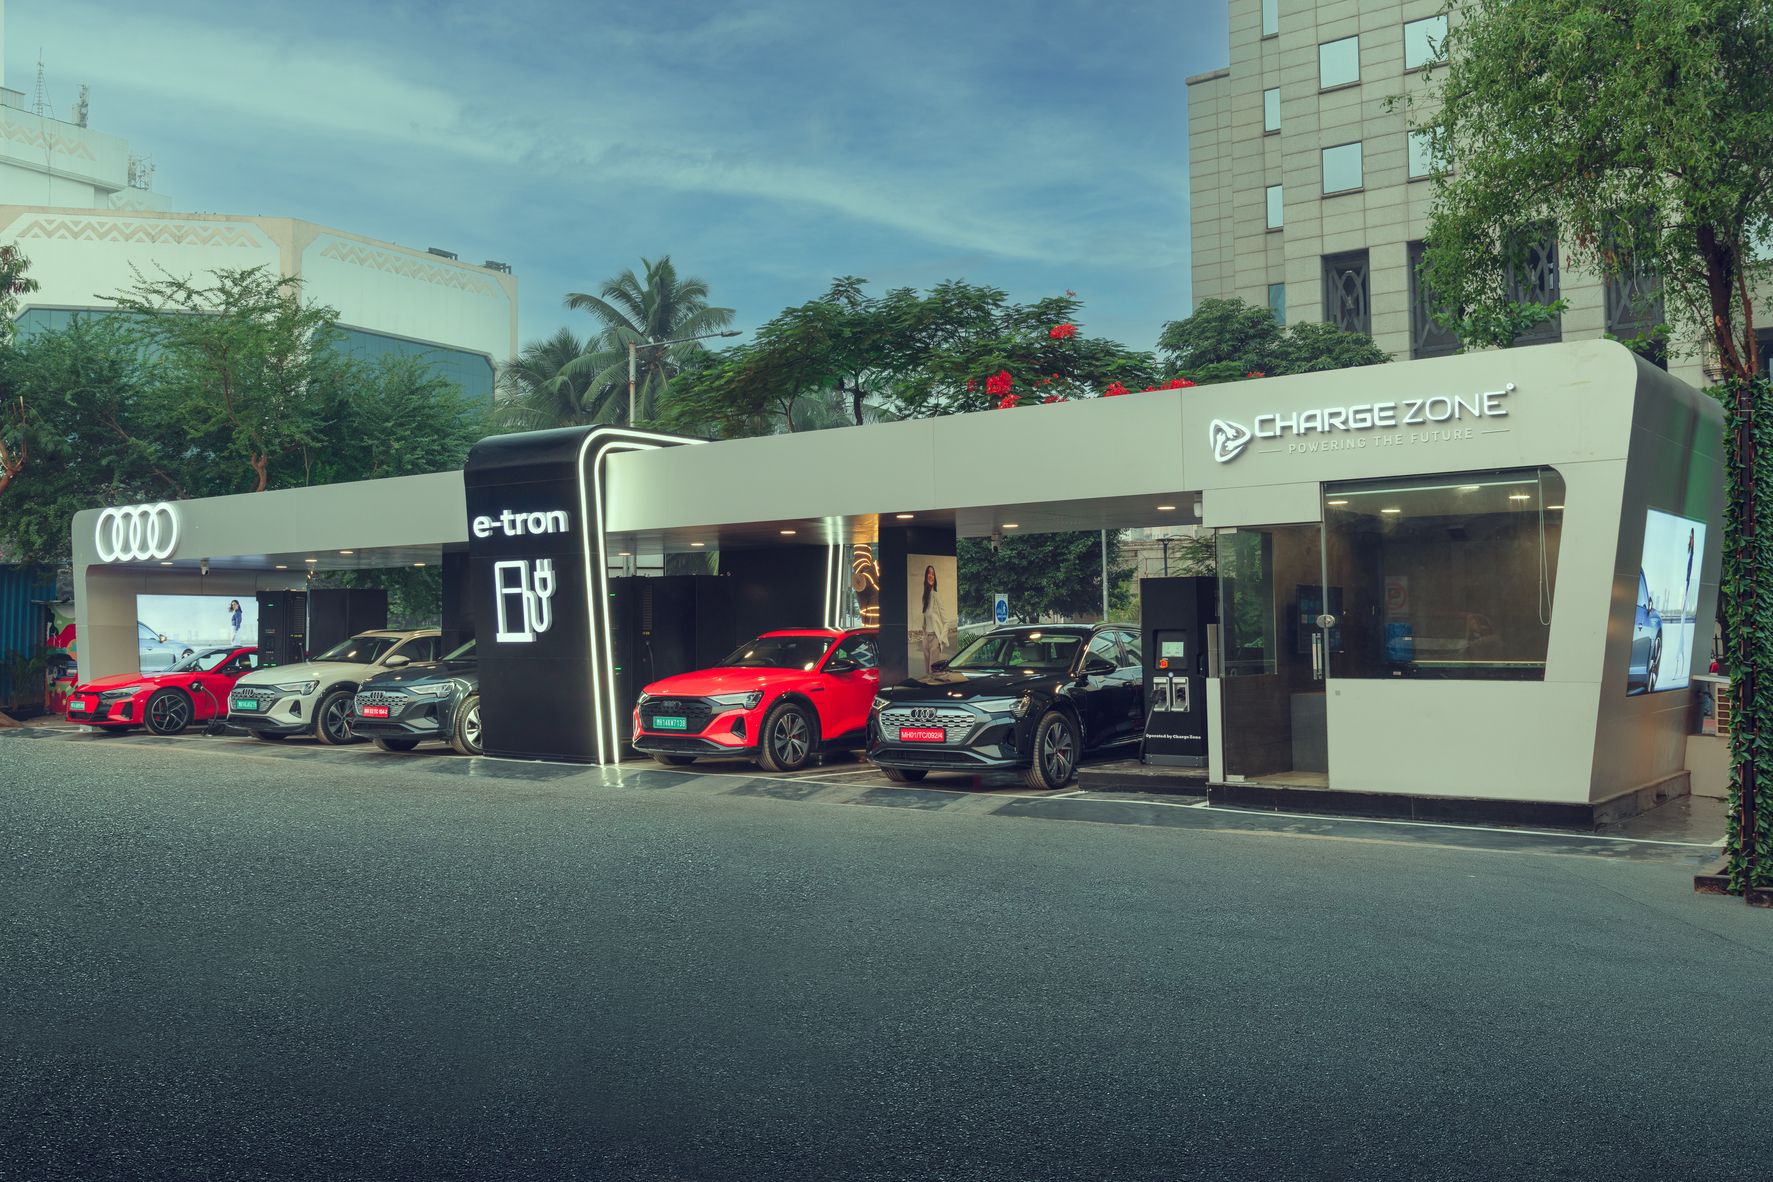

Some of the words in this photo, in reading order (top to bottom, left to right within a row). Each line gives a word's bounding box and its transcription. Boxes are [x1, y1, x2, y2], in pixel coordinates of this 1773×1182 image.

[1253, 401, 1397, 438] CHARGE
[1402, 390, 1510, 424] ZONE
[1288, 436, 1367, 455] POWERING
[1374, 433, 1404, 448] THE
[1410, 427, 1475, 445] FUTURE
[473, 509, 570, 538] e-tron
